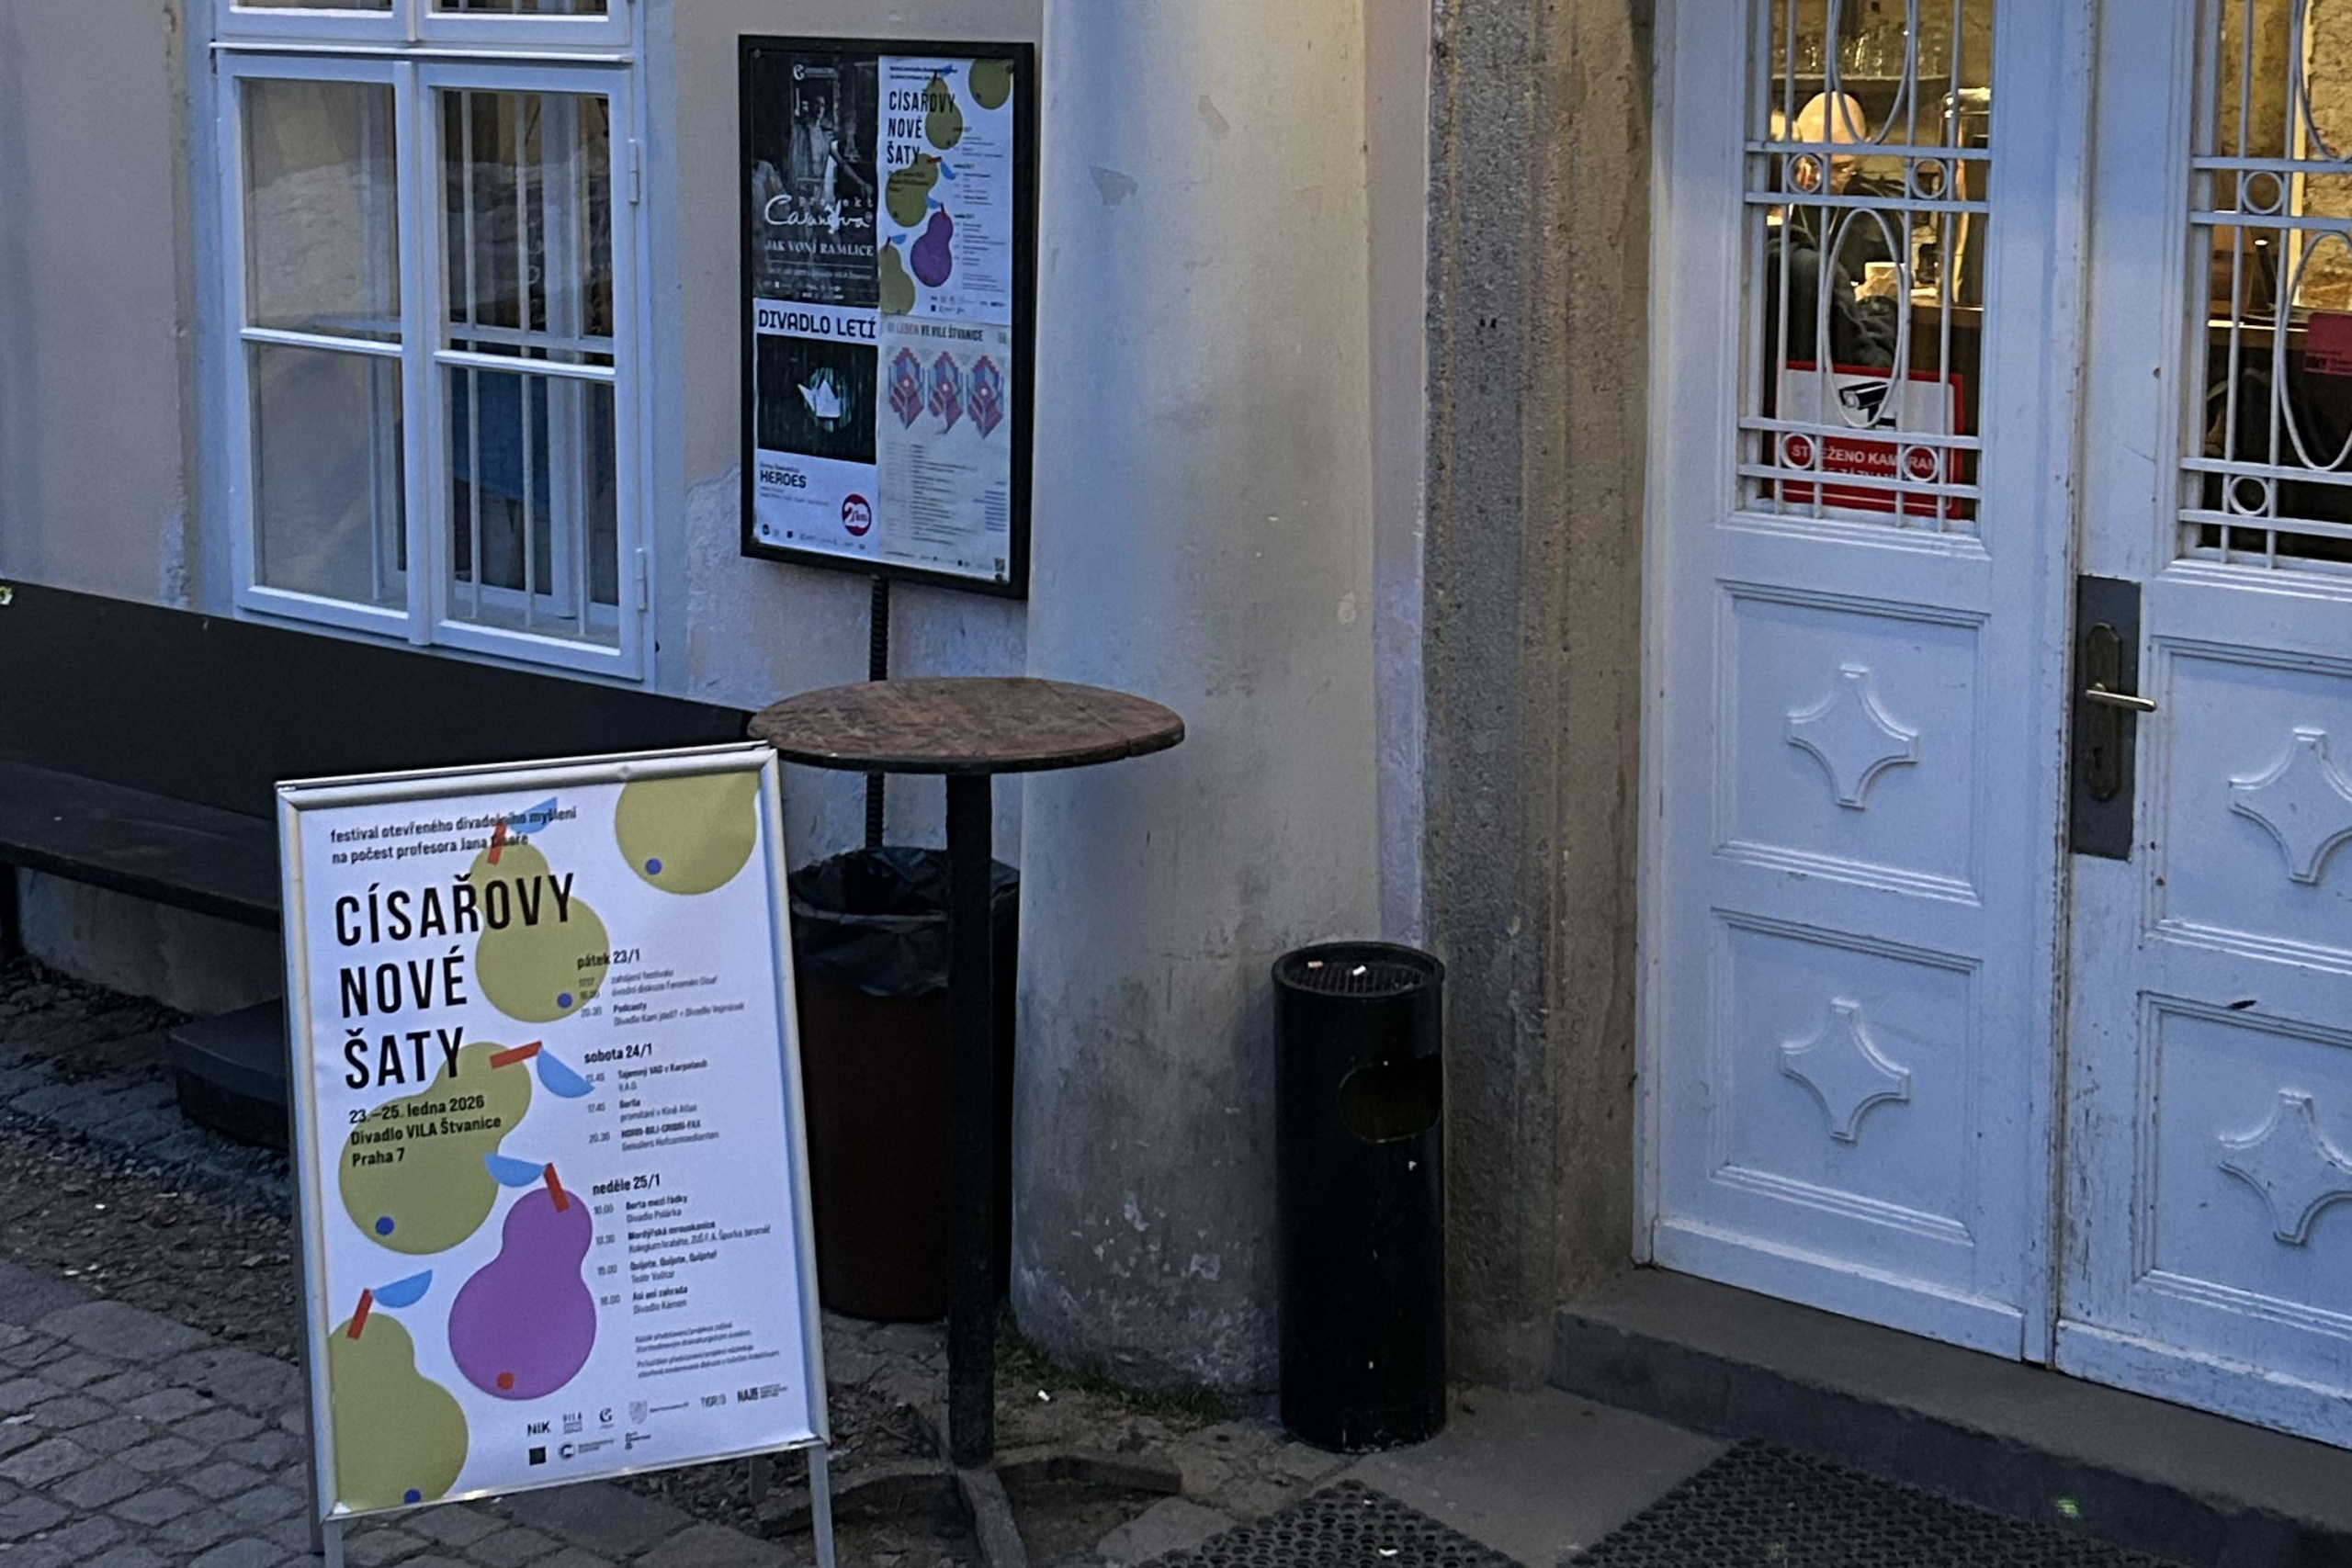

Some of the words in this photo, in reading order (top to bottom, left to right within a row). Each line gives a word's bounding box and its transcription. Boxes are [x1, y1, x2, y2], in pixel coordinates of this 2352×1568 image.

[889, 88, 955, 113] CÍSAŘOVY
[888, 115, 922, 139] NOVÉ
[887, 141, 920, 164] ŠATY
[759, 309, 831, 335] DIVADLO
[837, 316, 876, 339] LETÍ
[1792, 445, 1865, 463] STEŽENO
[760, 469, 807, 489] HEROES
[331, 823, 379, 842] festival
[382, 818, 453, 838] otevřeného
[332, 852, 347, 864] na
[351, 844, 393, 864] počest
[396, 840, 458, 860] profesora
[460, 836, 487, 851] Jana
[334, 873, 574, 946] CÍSAŘOVY
[577, 953, 610, 971] pátek
[613, 948, 640, 964] 23/1
[340, 946, 467, 1019] NOVÉ
[345, 1026, 465, 1090] ŠATY
[584, 1048, 624, 1064] sobota
[626, 1043, 652, 1058] 24/1
[407, 1100, 447, 1118] ledna
[449, 1094, 485, 1111] 2026
[350, 1127, 403, 1146] Divadlo
[406, 1122, 437, 1138] VILA
[441, 1115, 502, 1134] Štvanice
[352, 1150, 393, 1168] Praha
[396, 1147, 405, 1162] 7
[593, 1179, 631, 1195] neděle
[633, 1173, 661, 1190] 25/1
